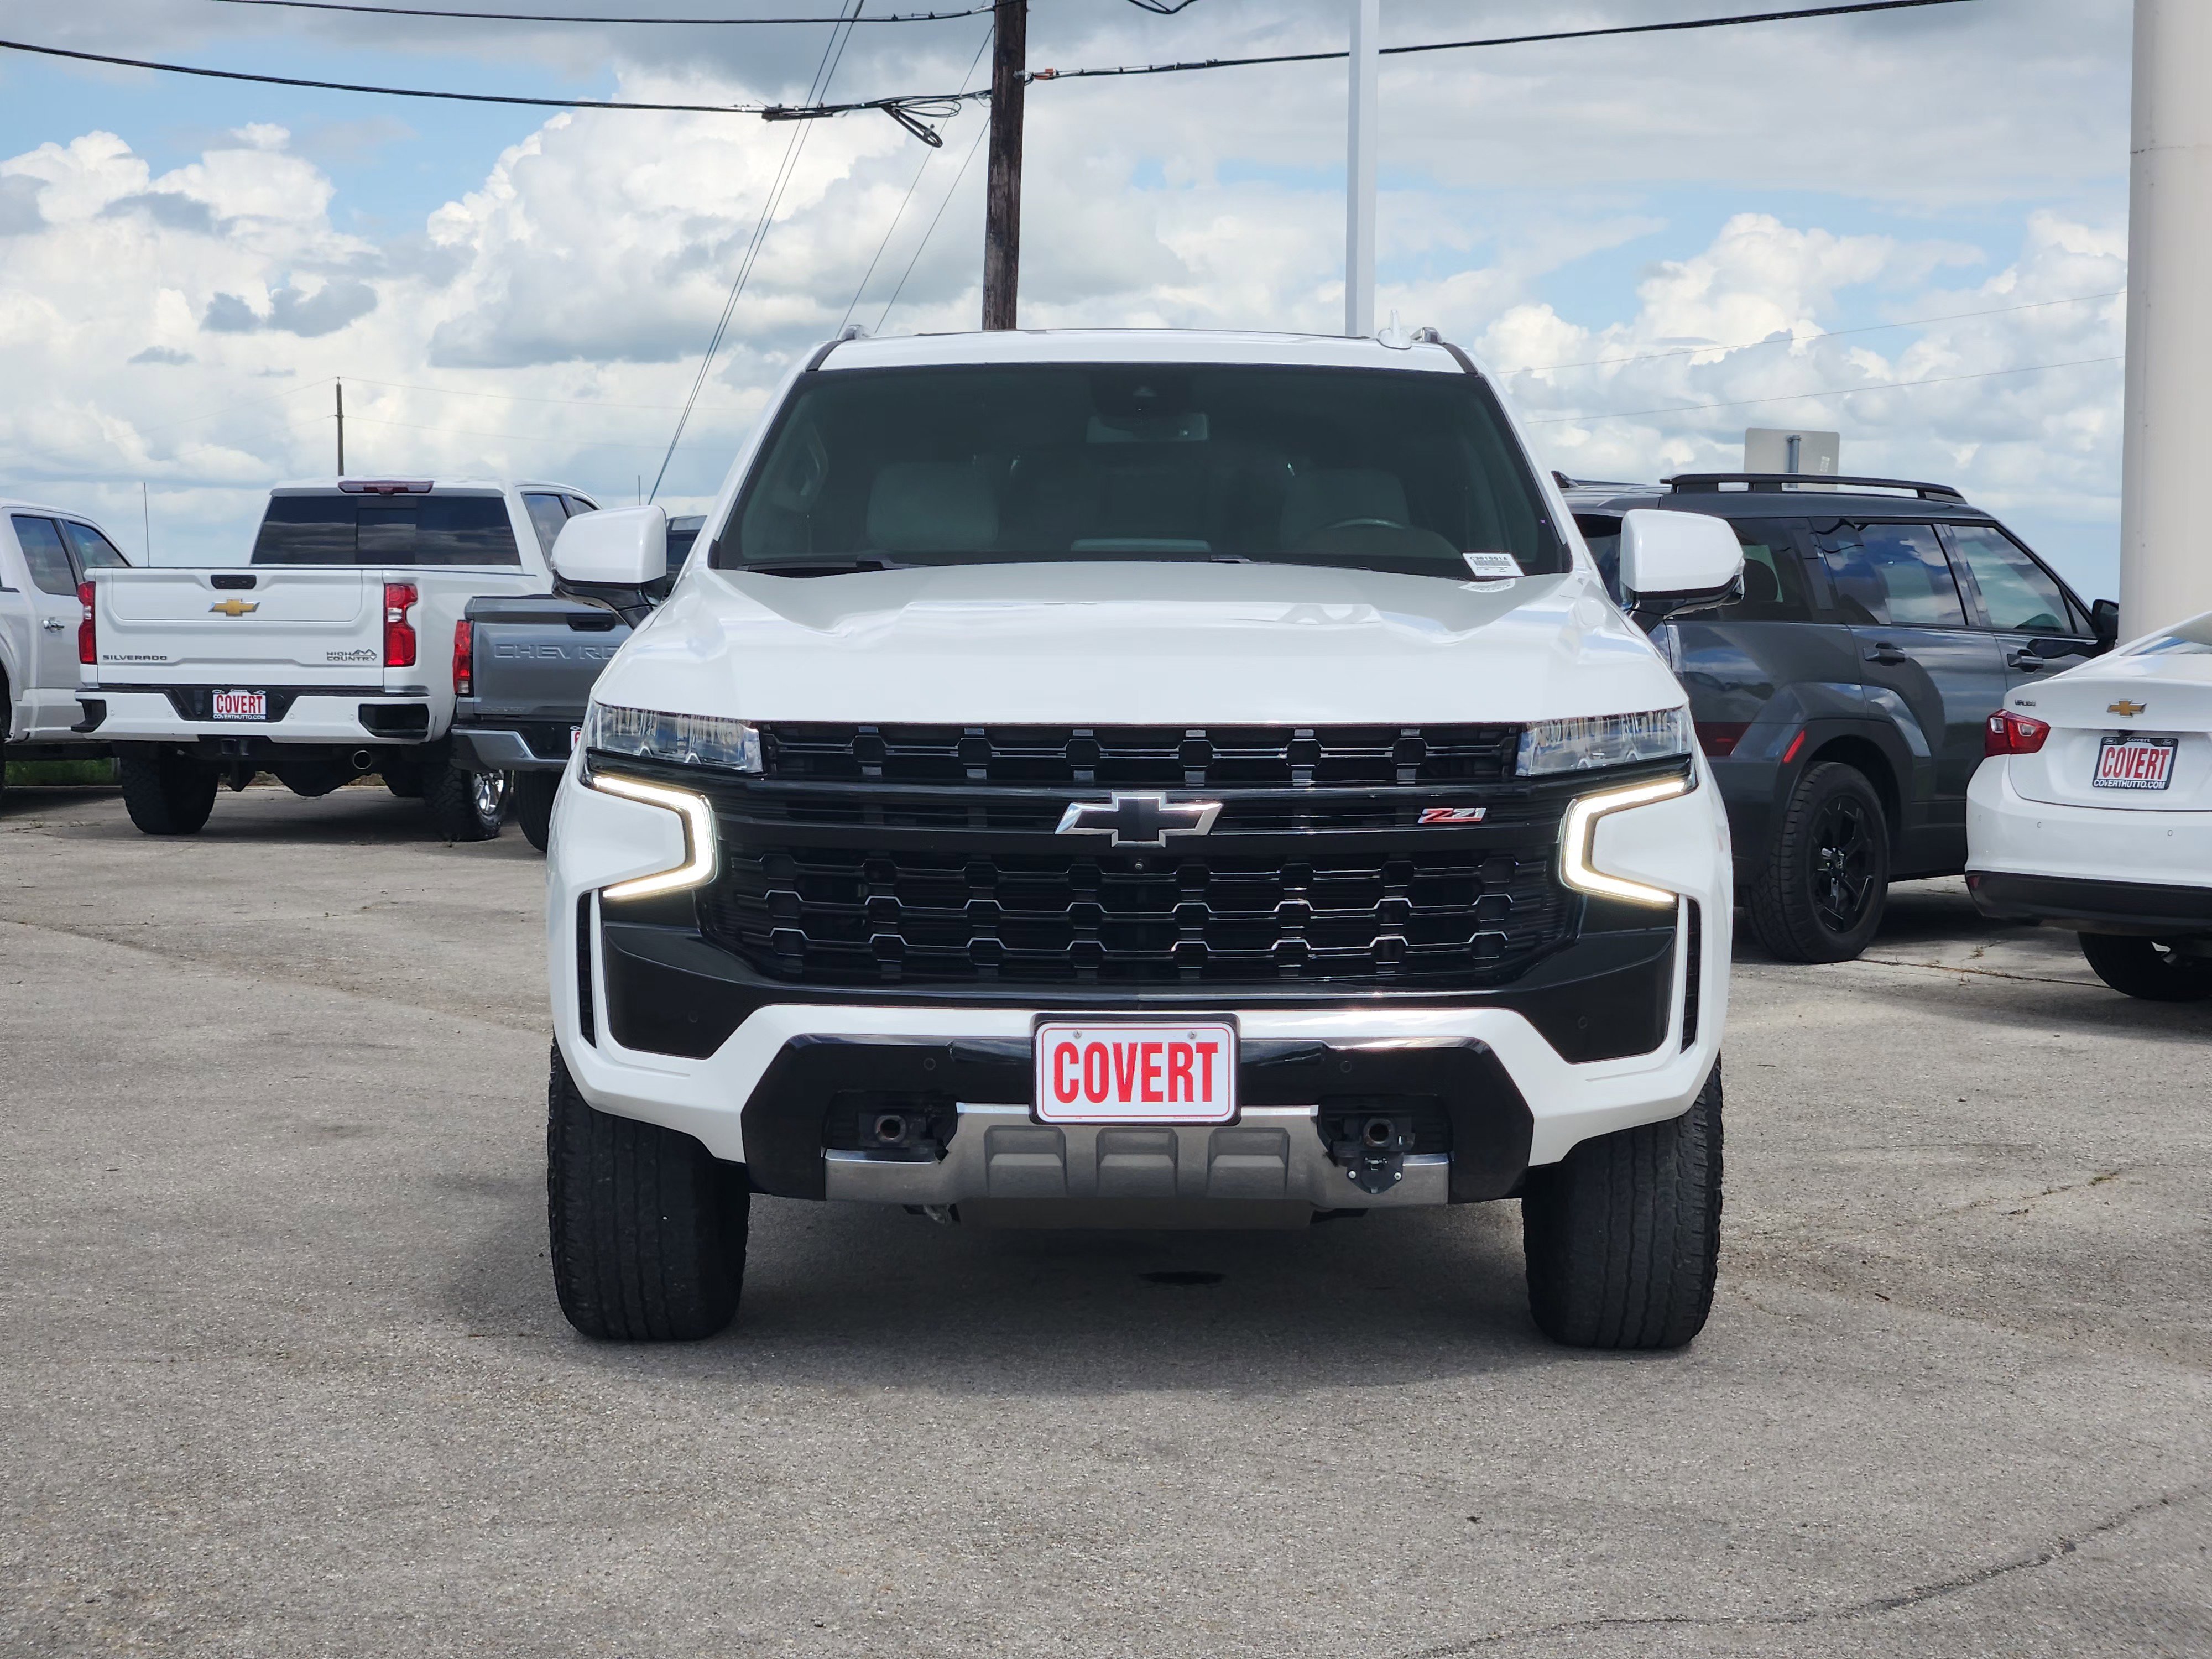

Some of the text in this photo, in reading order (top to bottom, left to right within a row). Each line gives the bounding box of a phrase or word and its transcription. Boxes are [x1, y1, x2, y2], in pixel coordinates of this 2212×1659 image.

[216, 695, 263, 713] COVERT
[2102, 747, 2170, 780] COVERT
[2094, 779, 2166, 789] COVERTHUTTO.COM
[1418, 808, 1486, 823] Z71
[1054, 1041, 1219, 1103] COVERT
